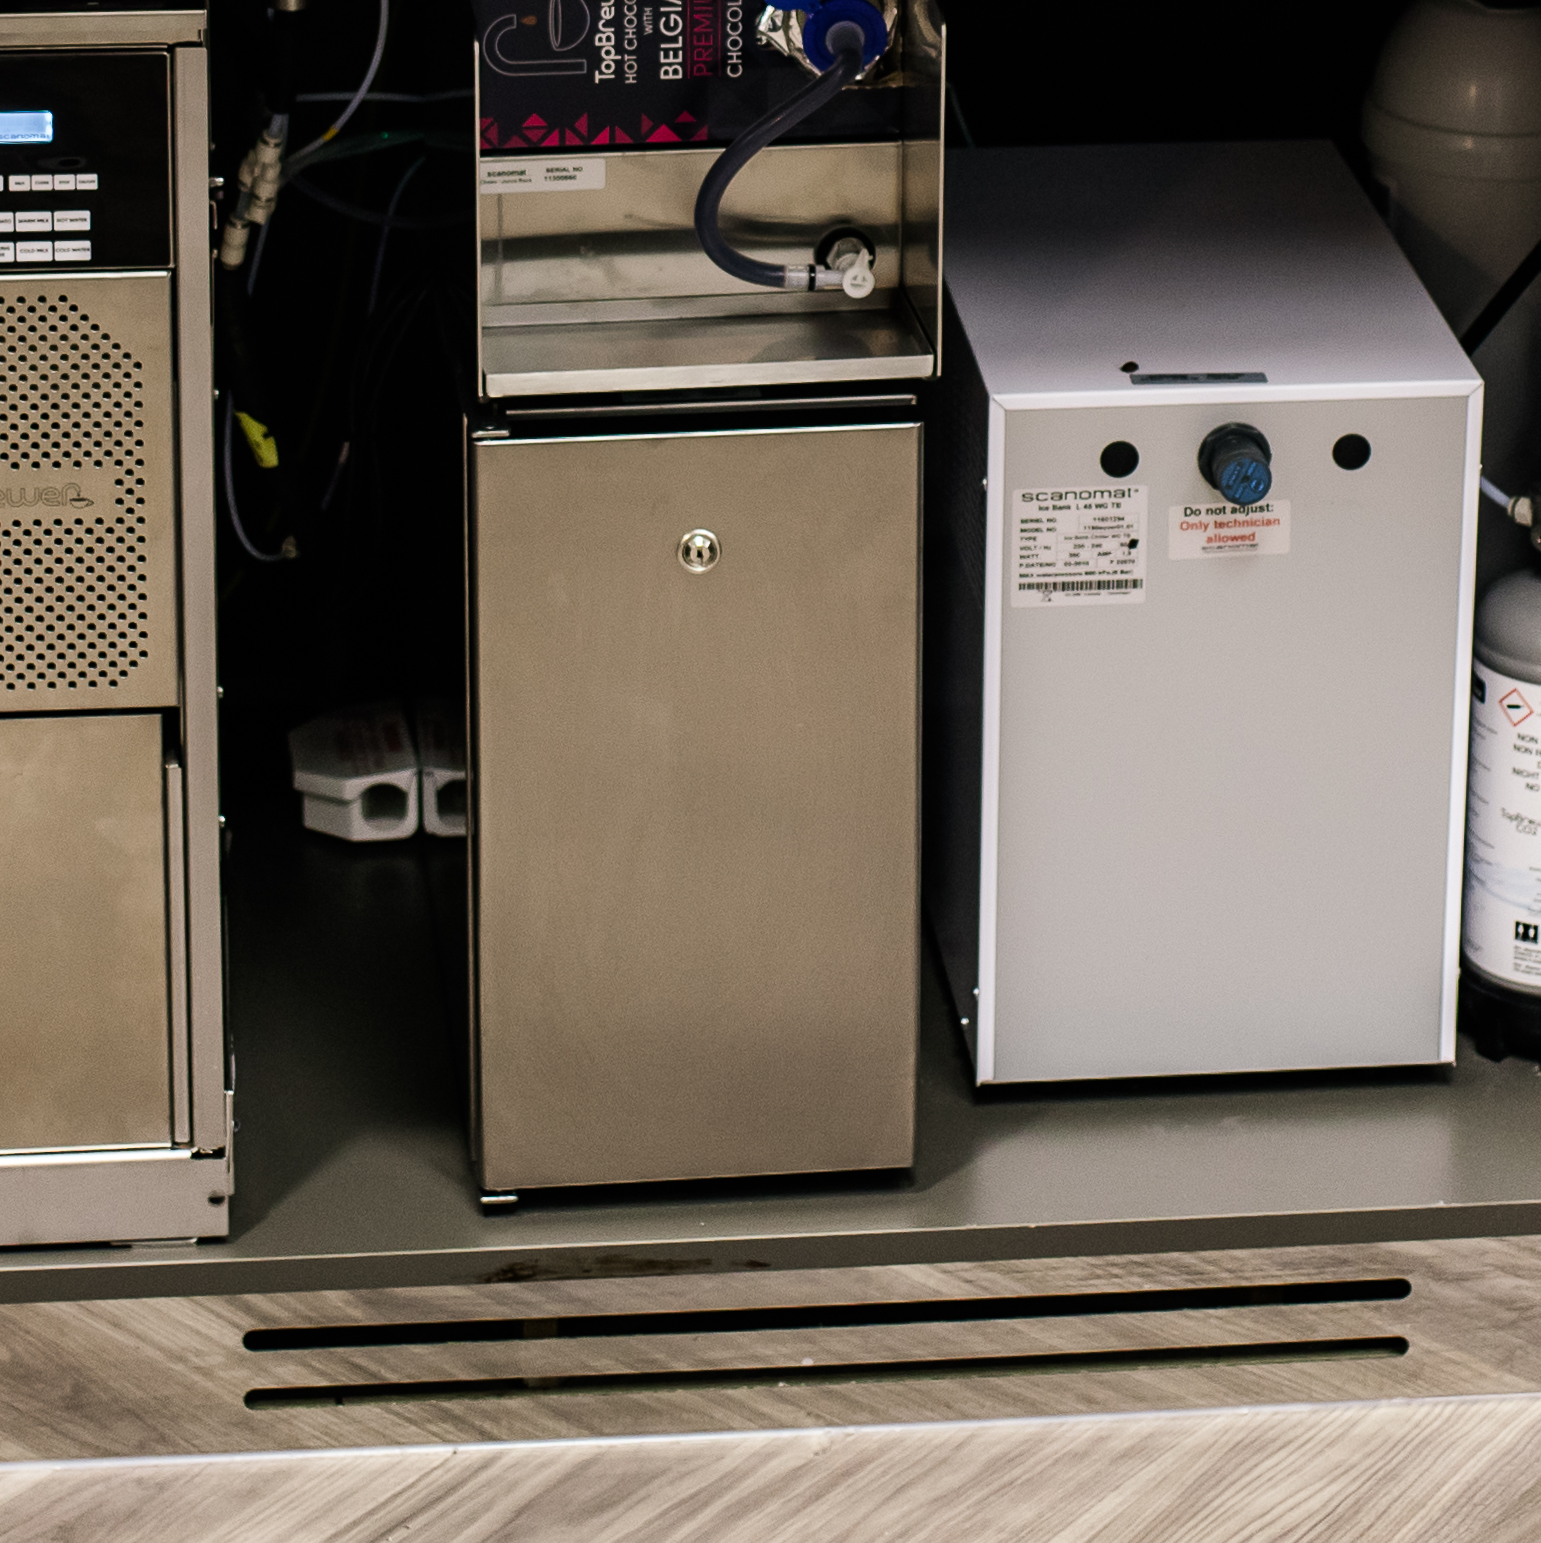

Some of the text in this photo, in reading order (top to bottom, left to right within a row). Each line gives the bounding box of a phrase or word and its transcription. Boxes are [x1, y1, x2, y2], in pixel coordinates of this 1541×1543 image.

[643, 7, 654, 36] WITH
[623, 53, 638, 85] HOT
[1021, 488, 1132, 503] scanomat
[1183, 506, 1202, 517] Do
[1206, 505, 1227, 516] not
[1179, 516, 1281, 533] Only technician
[1205, 531, 1257, 544] allowed
